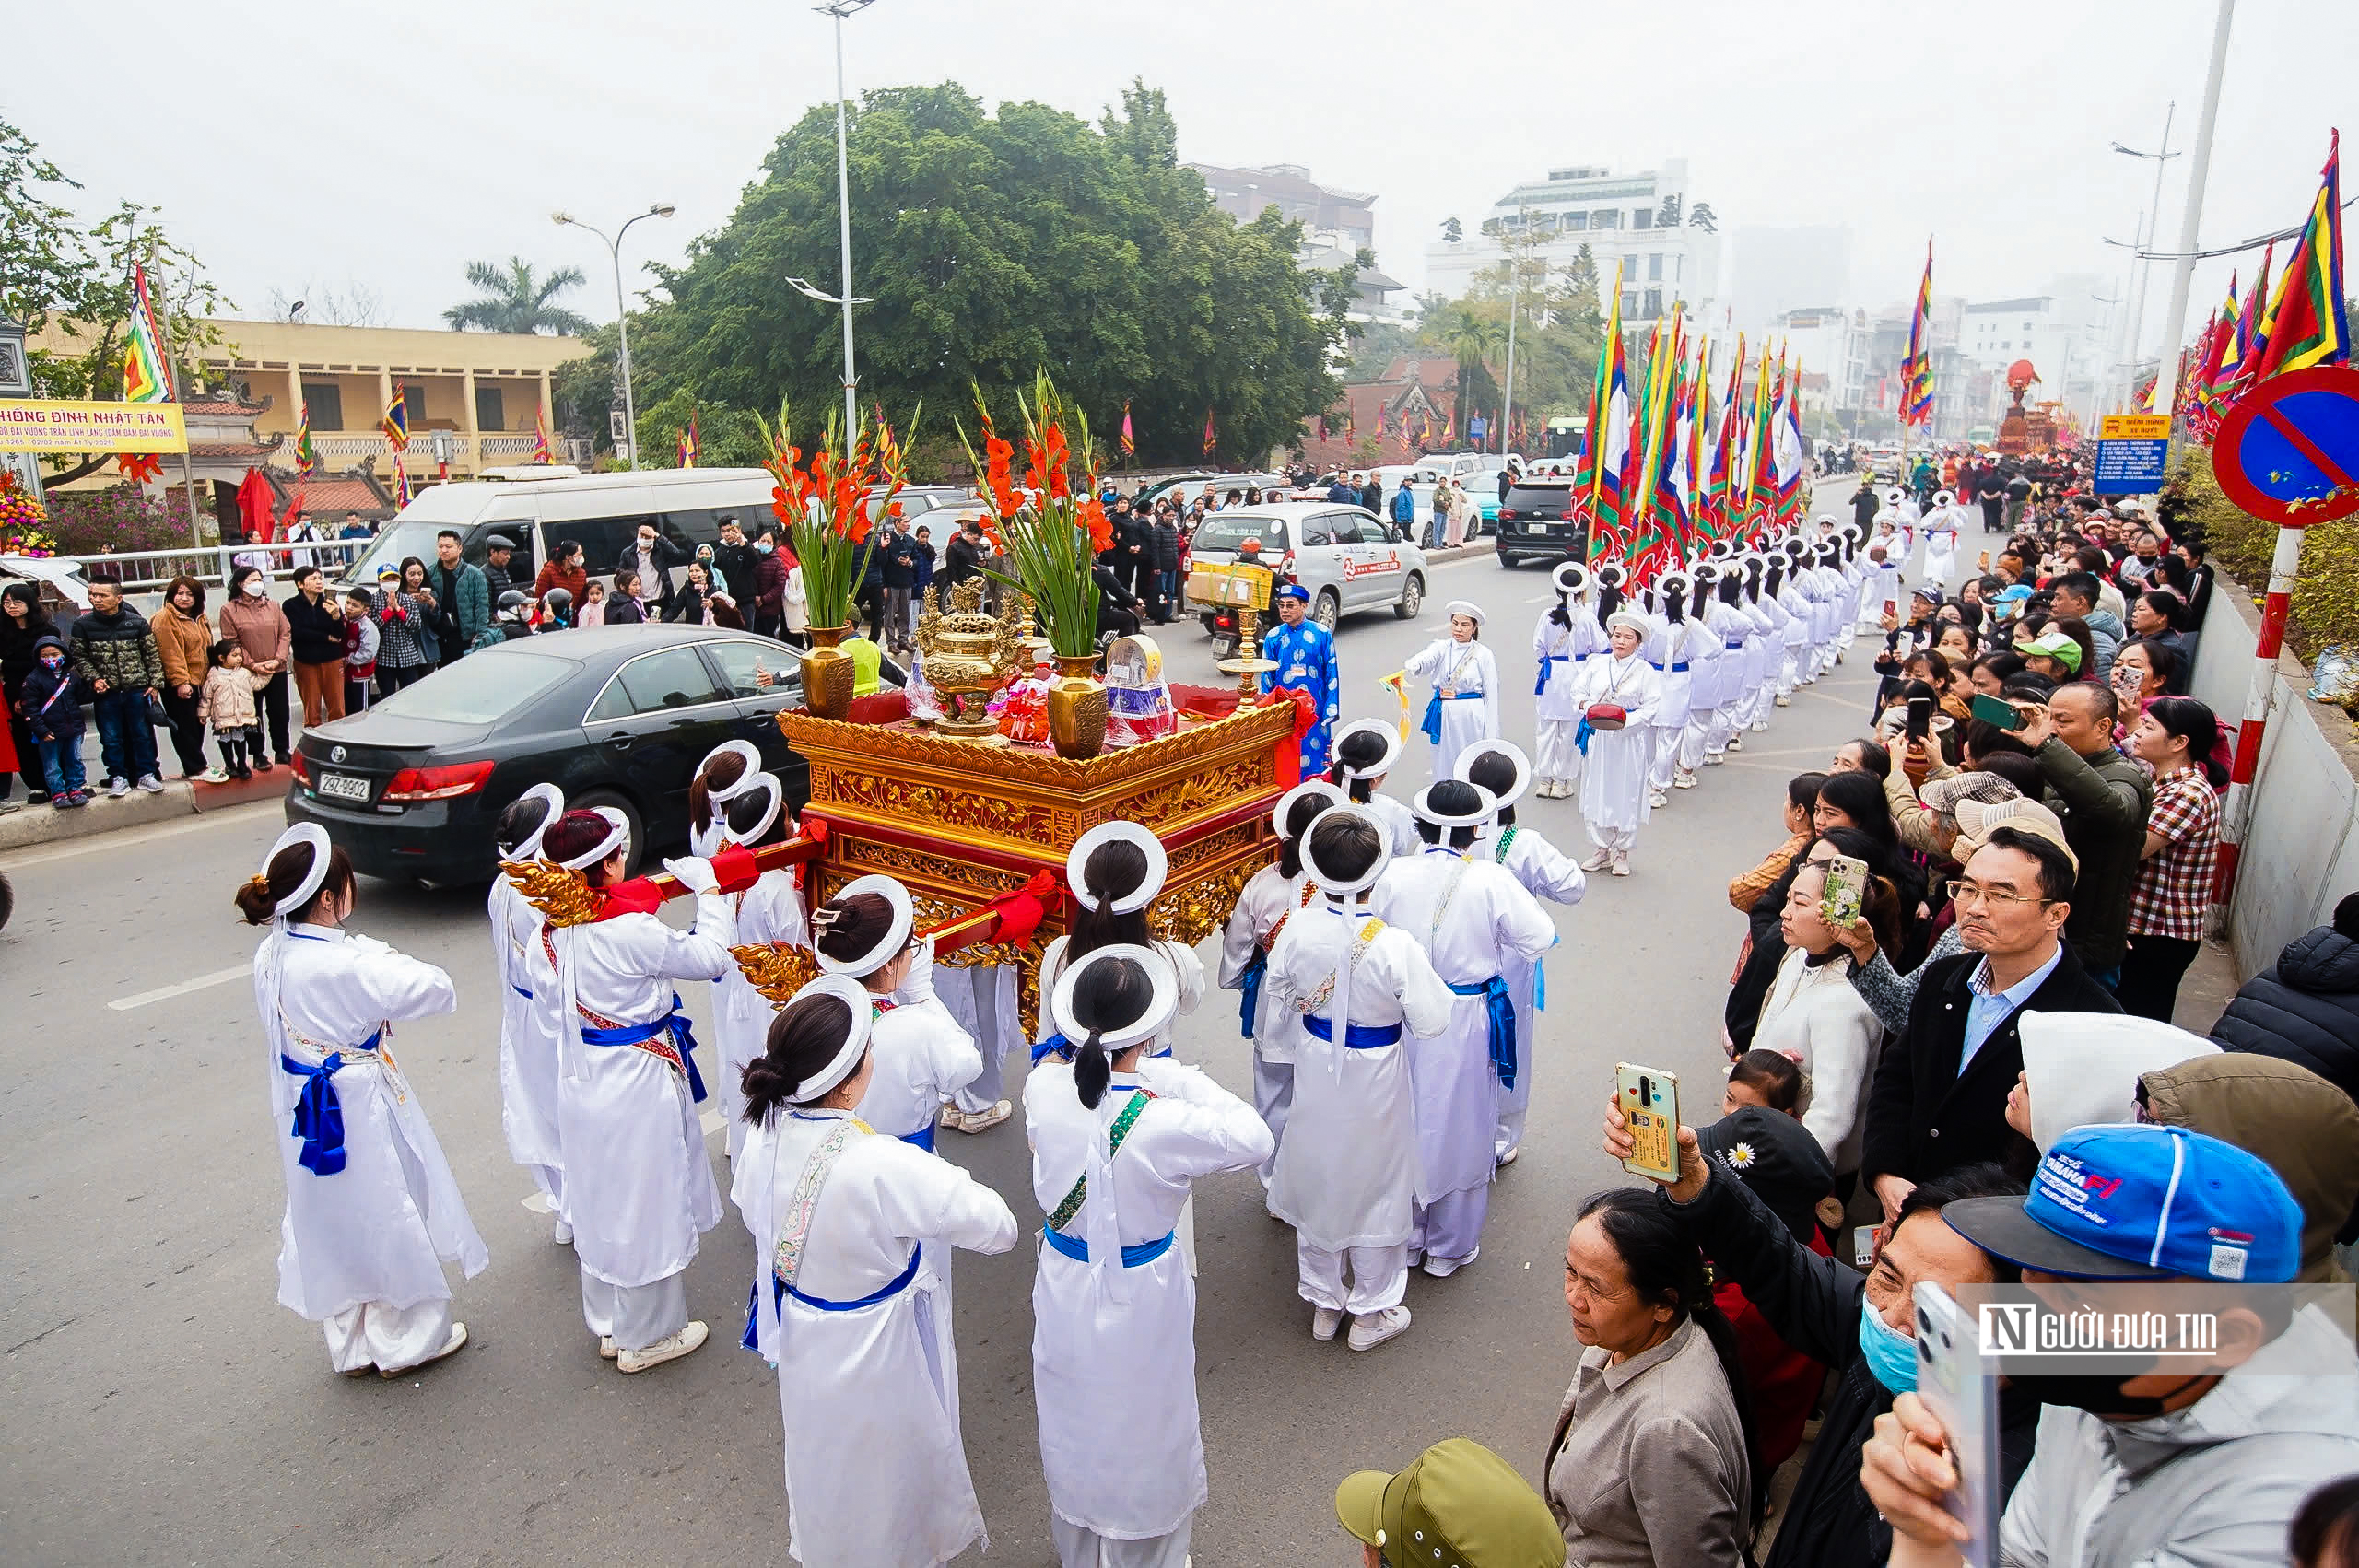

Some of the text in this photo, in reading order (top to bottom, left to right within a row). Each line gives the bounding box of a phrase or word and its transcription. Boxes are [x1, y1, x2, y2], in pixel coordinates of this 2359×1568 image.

[51, 409, 88, 423] ĐÌNH
[93, 410, 134, 427] NHẬT
[137, 411, 165, 424] TÂN
[323, 776, 366, 797] 29Z-9902
[2046, 1156, 2086, 1188] YAMAHA
